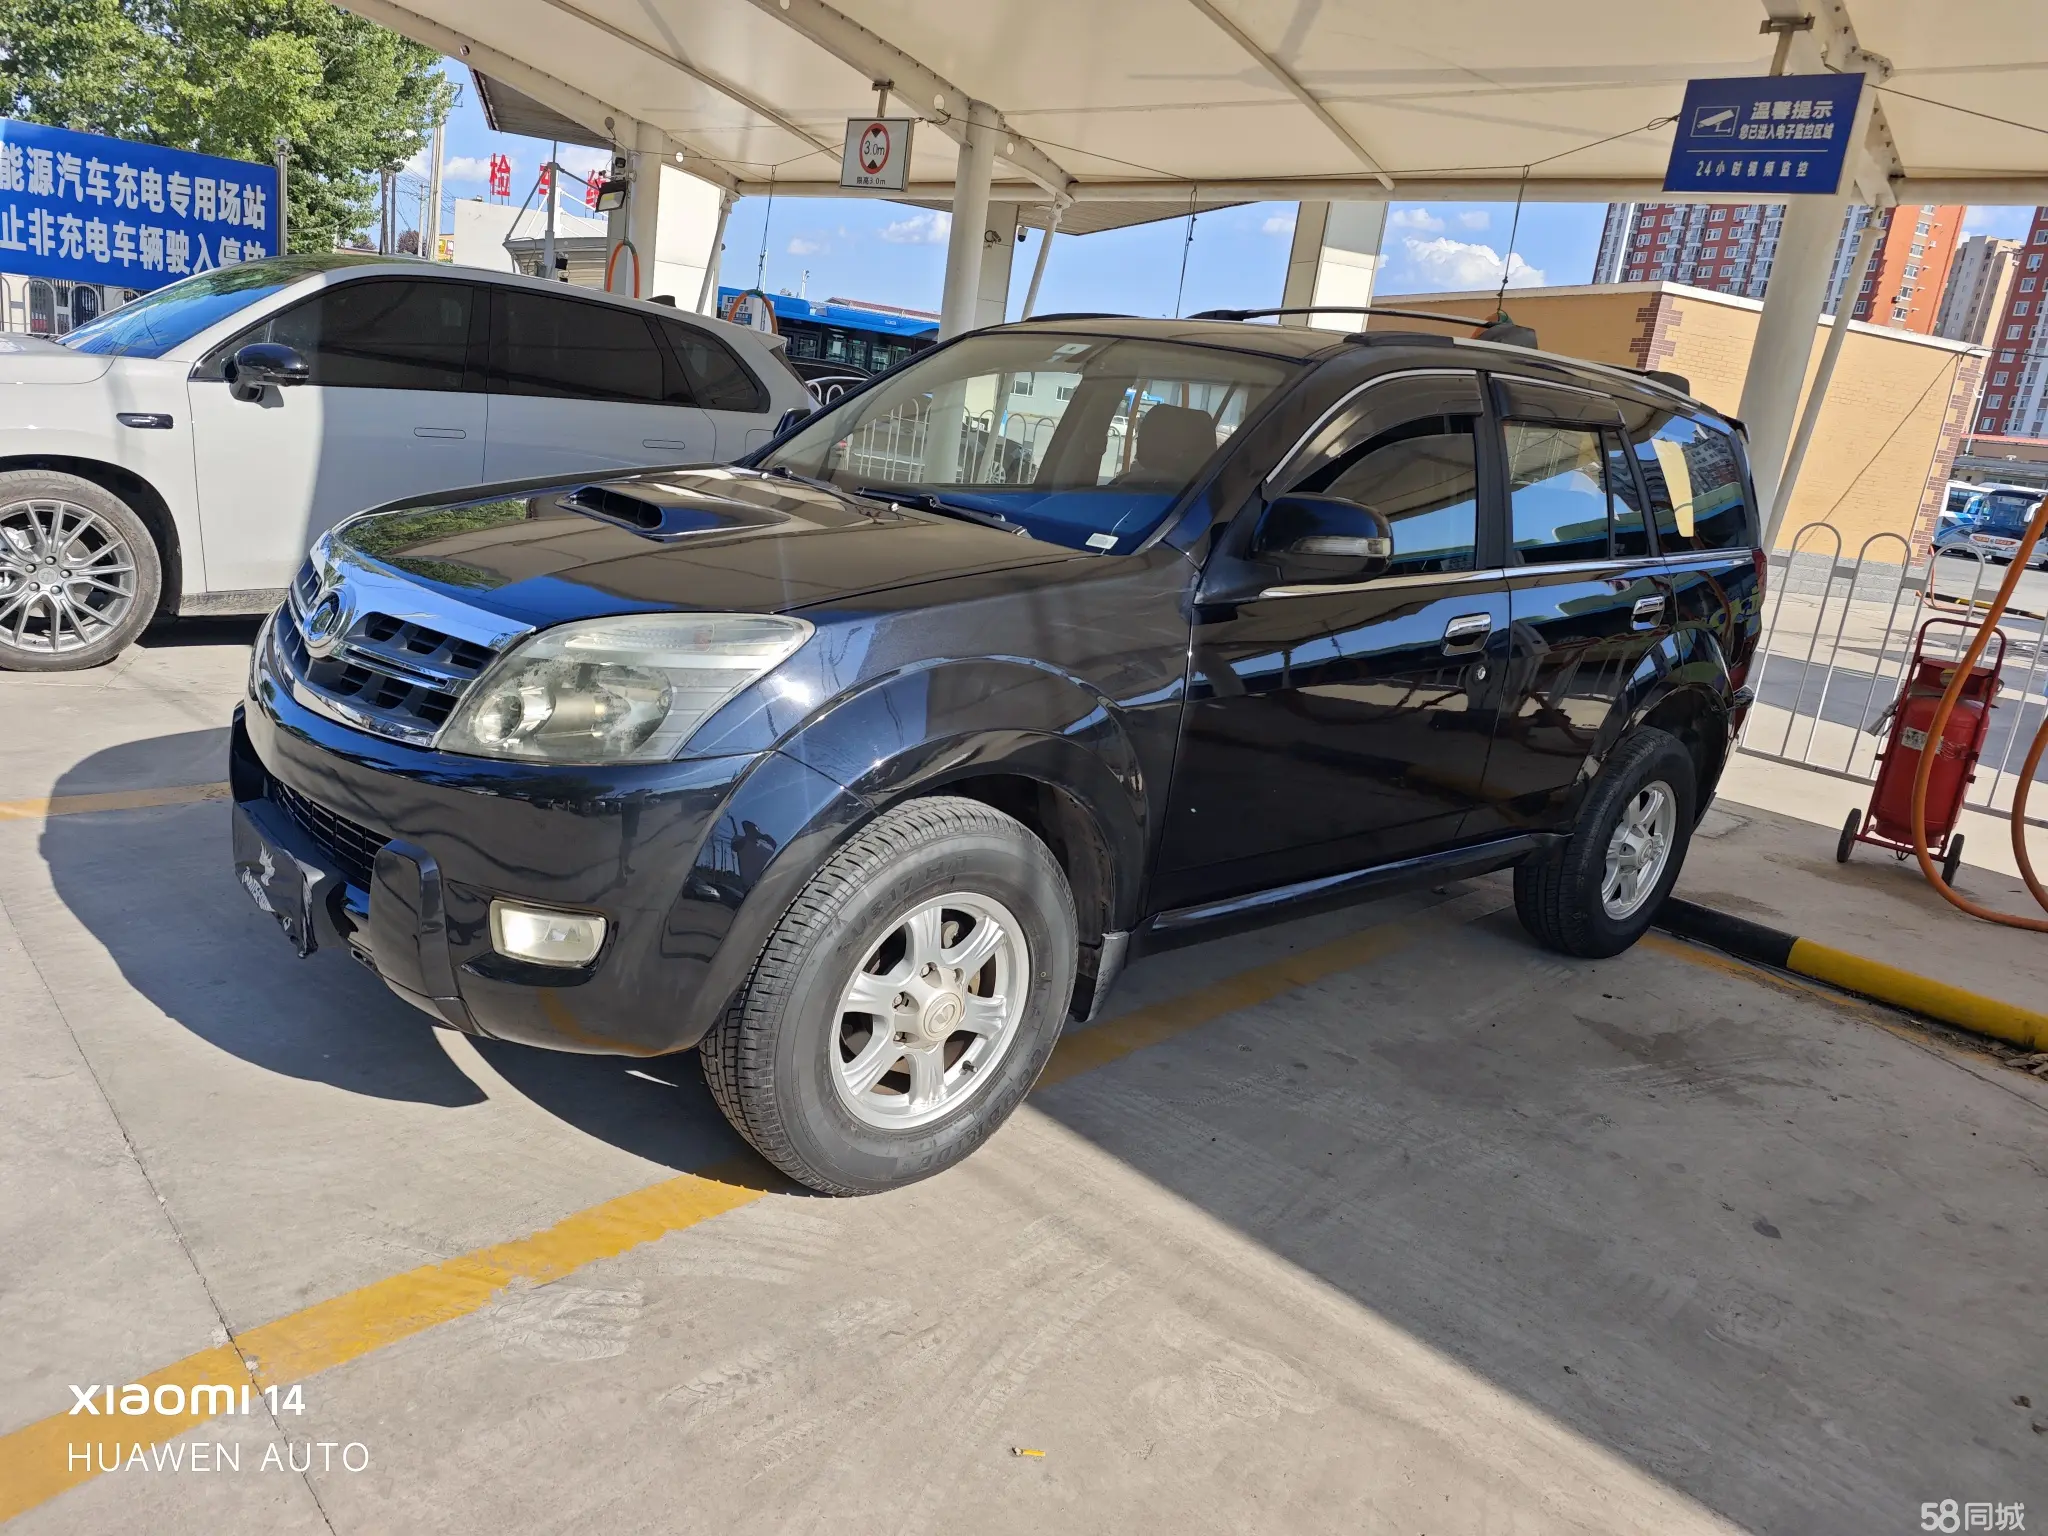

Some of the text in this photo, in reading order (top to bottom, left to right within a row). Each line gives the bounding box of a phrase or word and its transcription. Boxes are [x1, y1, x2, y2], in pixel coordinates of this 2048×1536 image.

[1750, 100, 1834, 121] 温馨提示
[1738, 123, 1834, 140] 您已进入电子监控区域
[863, 140, 885, 156] 3.0m
[1695, 160, 1809, 178] 24小时视频监控
[0, 142, 266, 231] 能源汽车充电专用场站
